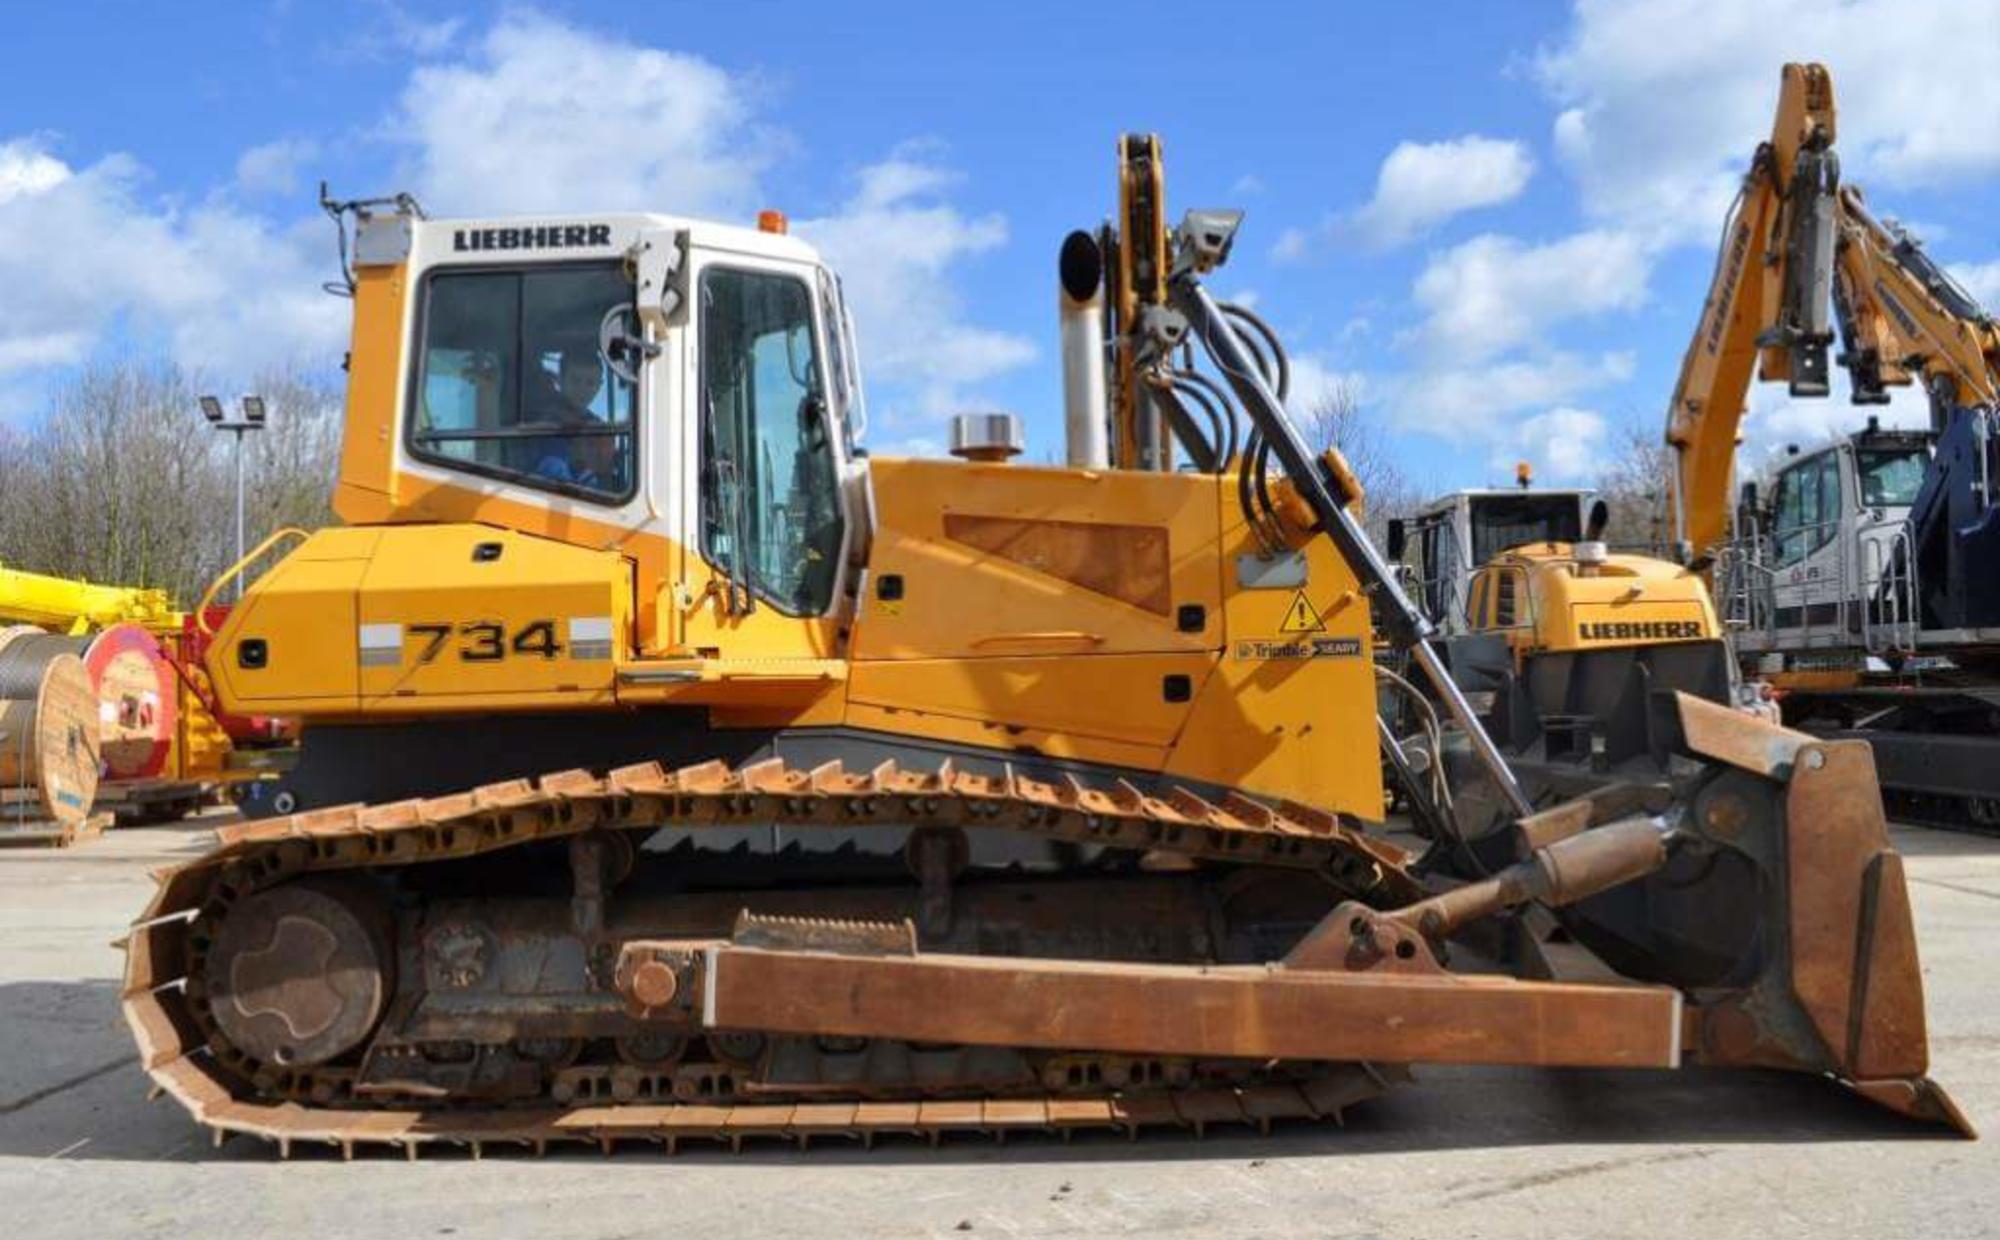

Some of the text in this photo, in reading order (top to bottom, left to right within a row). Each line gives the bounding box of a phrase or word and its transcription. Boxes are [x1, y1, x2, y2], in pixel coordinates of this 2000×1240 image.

[453, 224, 611, 251] LIEBHERR
[405, 619, 563, 665] 734
[1579, 621, 1702, 640] LIEBHERR
[1253, 642, 1309, 657] Trimble
